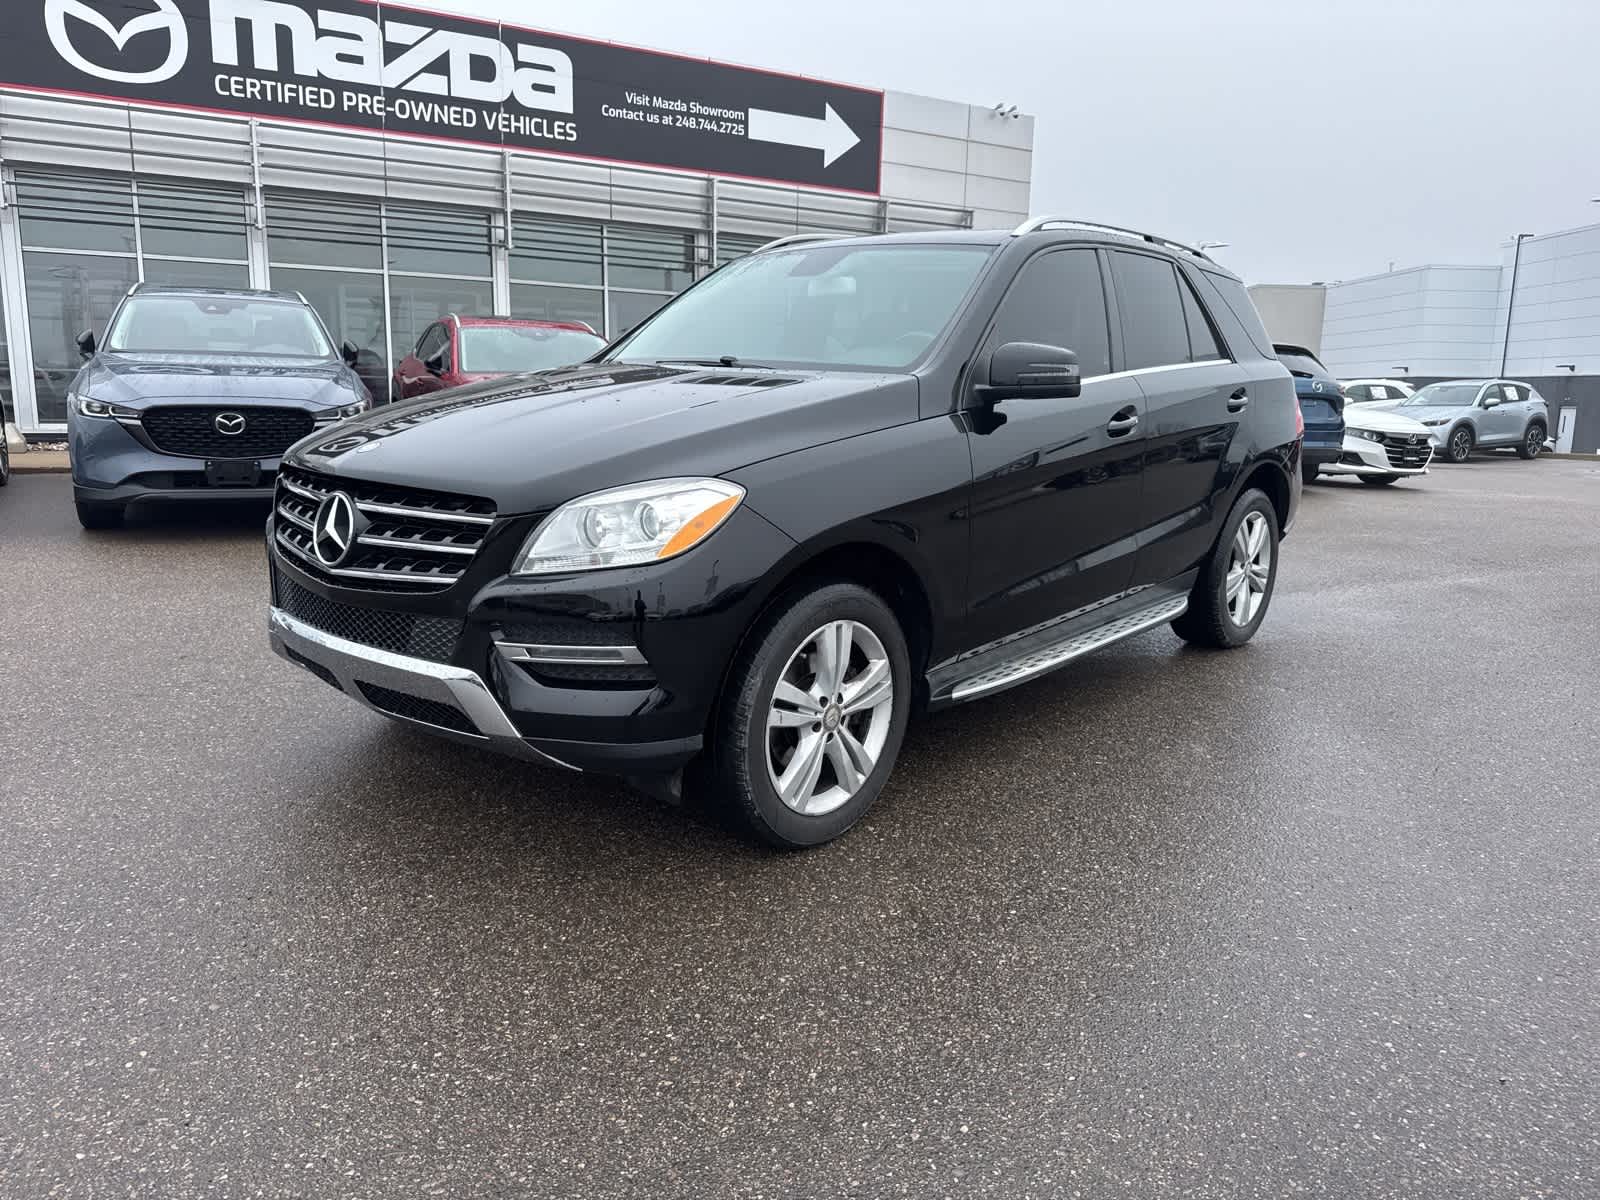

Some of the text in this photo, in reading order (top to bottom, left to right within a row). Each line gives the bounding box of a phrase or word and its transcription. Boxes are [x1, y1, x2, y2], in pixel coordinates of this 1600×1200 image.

[214, 74, 577, 141] CERTIFIED PRE-OWNED VEHICLES
[601, 104, 745, 136] Contact us at 248.744.2725
[625, 91, 745, 121] Visit Mazda Showroom
